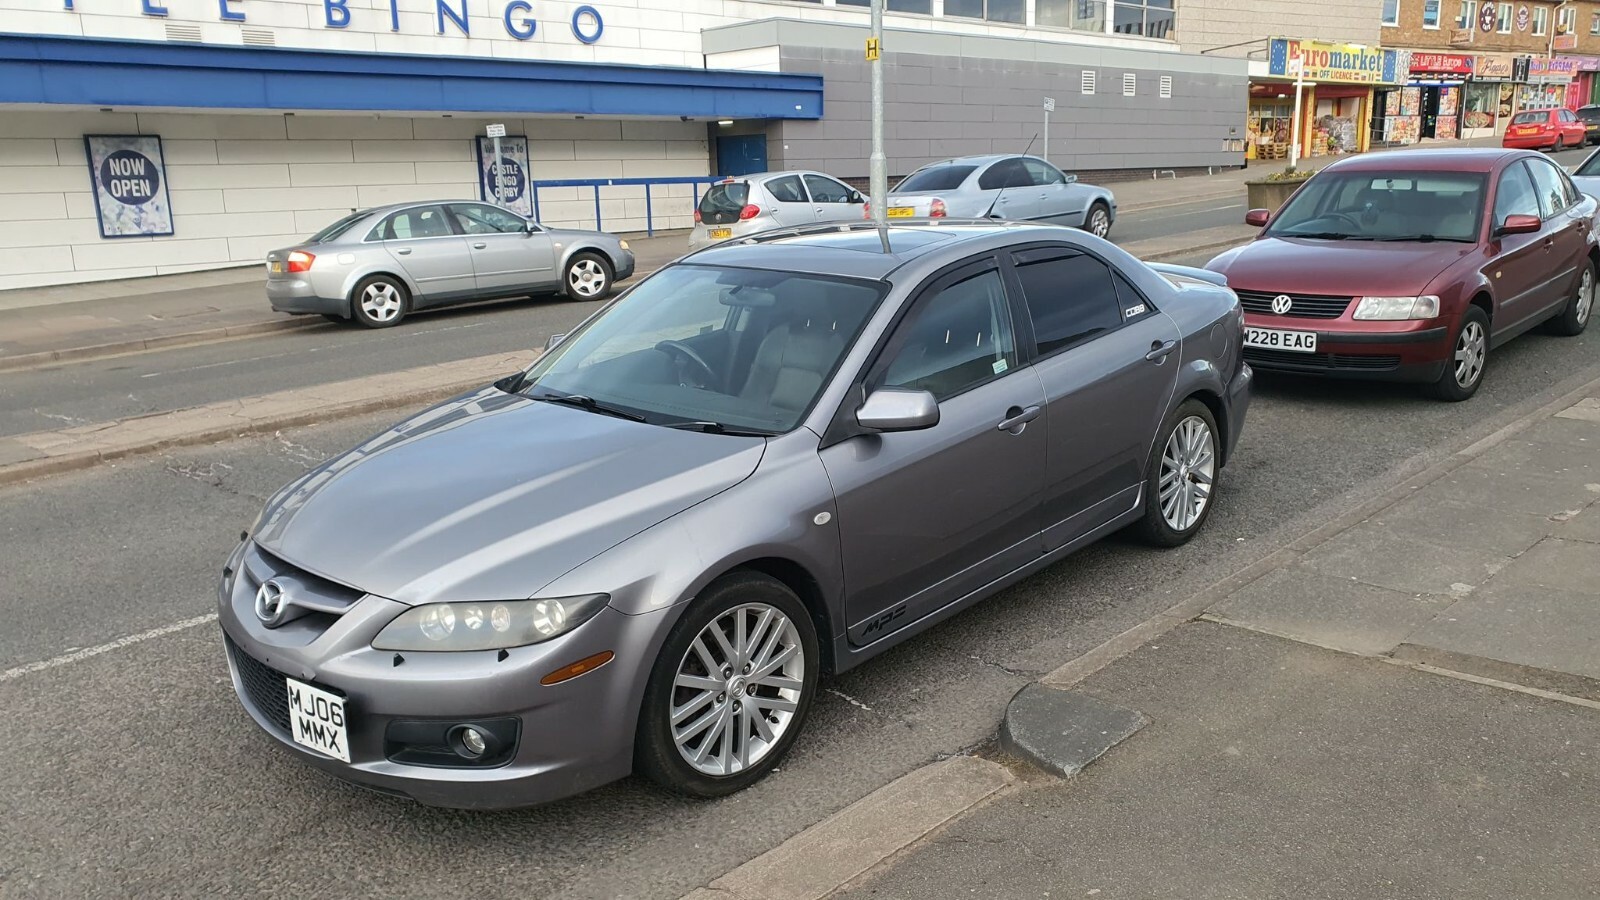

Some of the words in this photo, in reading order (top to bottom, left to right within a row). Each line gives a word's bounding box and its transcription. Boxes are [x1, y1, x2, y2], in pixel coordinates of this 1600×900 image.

[324, 0, 604, 44] BINGO
[867, 39, 877, 58] H
[1289, 40, 1382, 72] Euromarket
[1319, 70, 1330, 79] OFF
[1330, 71, 1353, 80] LICENCE
[108, 158, 145, 176] NOW
[491, 164, 518, 175] CSTLE
[110, 179, 151, 198] OPEN
[494, 187, 519, 198] CRBY
[1283, 333, 1314, 349] EAG
[289, 685, 344, 728] MJ06
[299, 715, 341, 754] MMX
